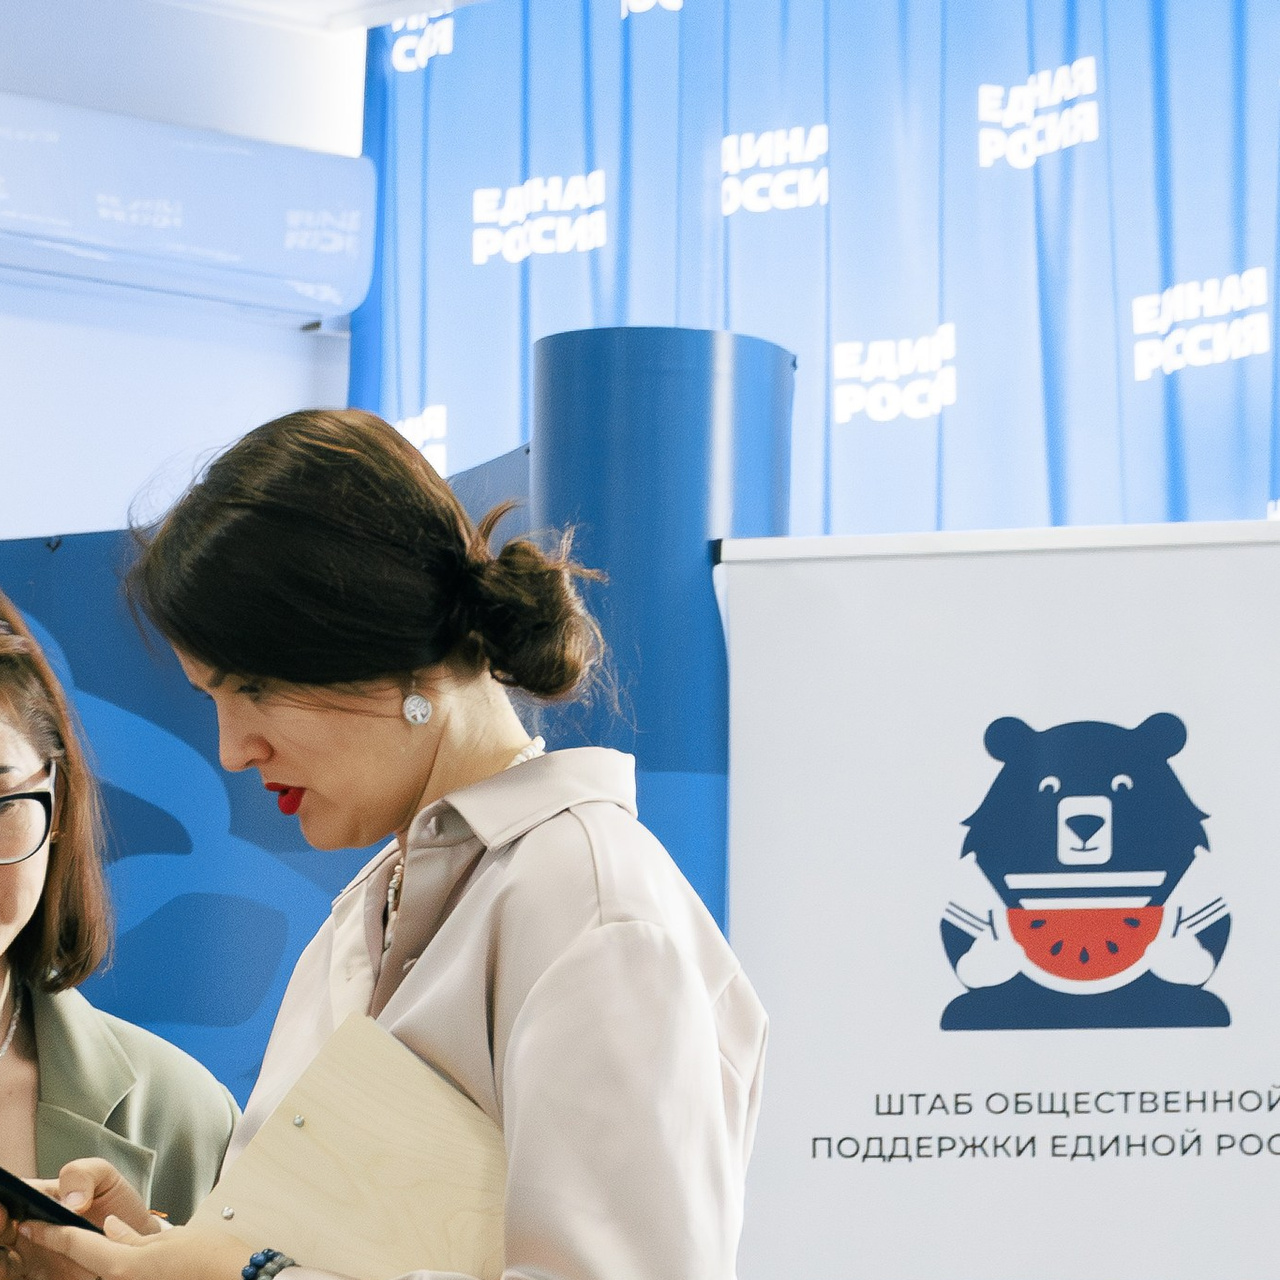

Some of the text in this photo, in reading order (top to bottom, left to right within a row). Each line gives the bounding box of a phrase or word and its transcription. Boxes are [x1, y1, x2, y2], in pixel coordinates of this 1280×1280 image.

[875, 1084, 1280, 1118] ШТАБ ОБЩЕСТВЕННОЙ
[812, 1135, 1037, 1163] ПОДДЕРЖКИ
[1051, 1128, 1202, 1162] ЕДИНОЙ
